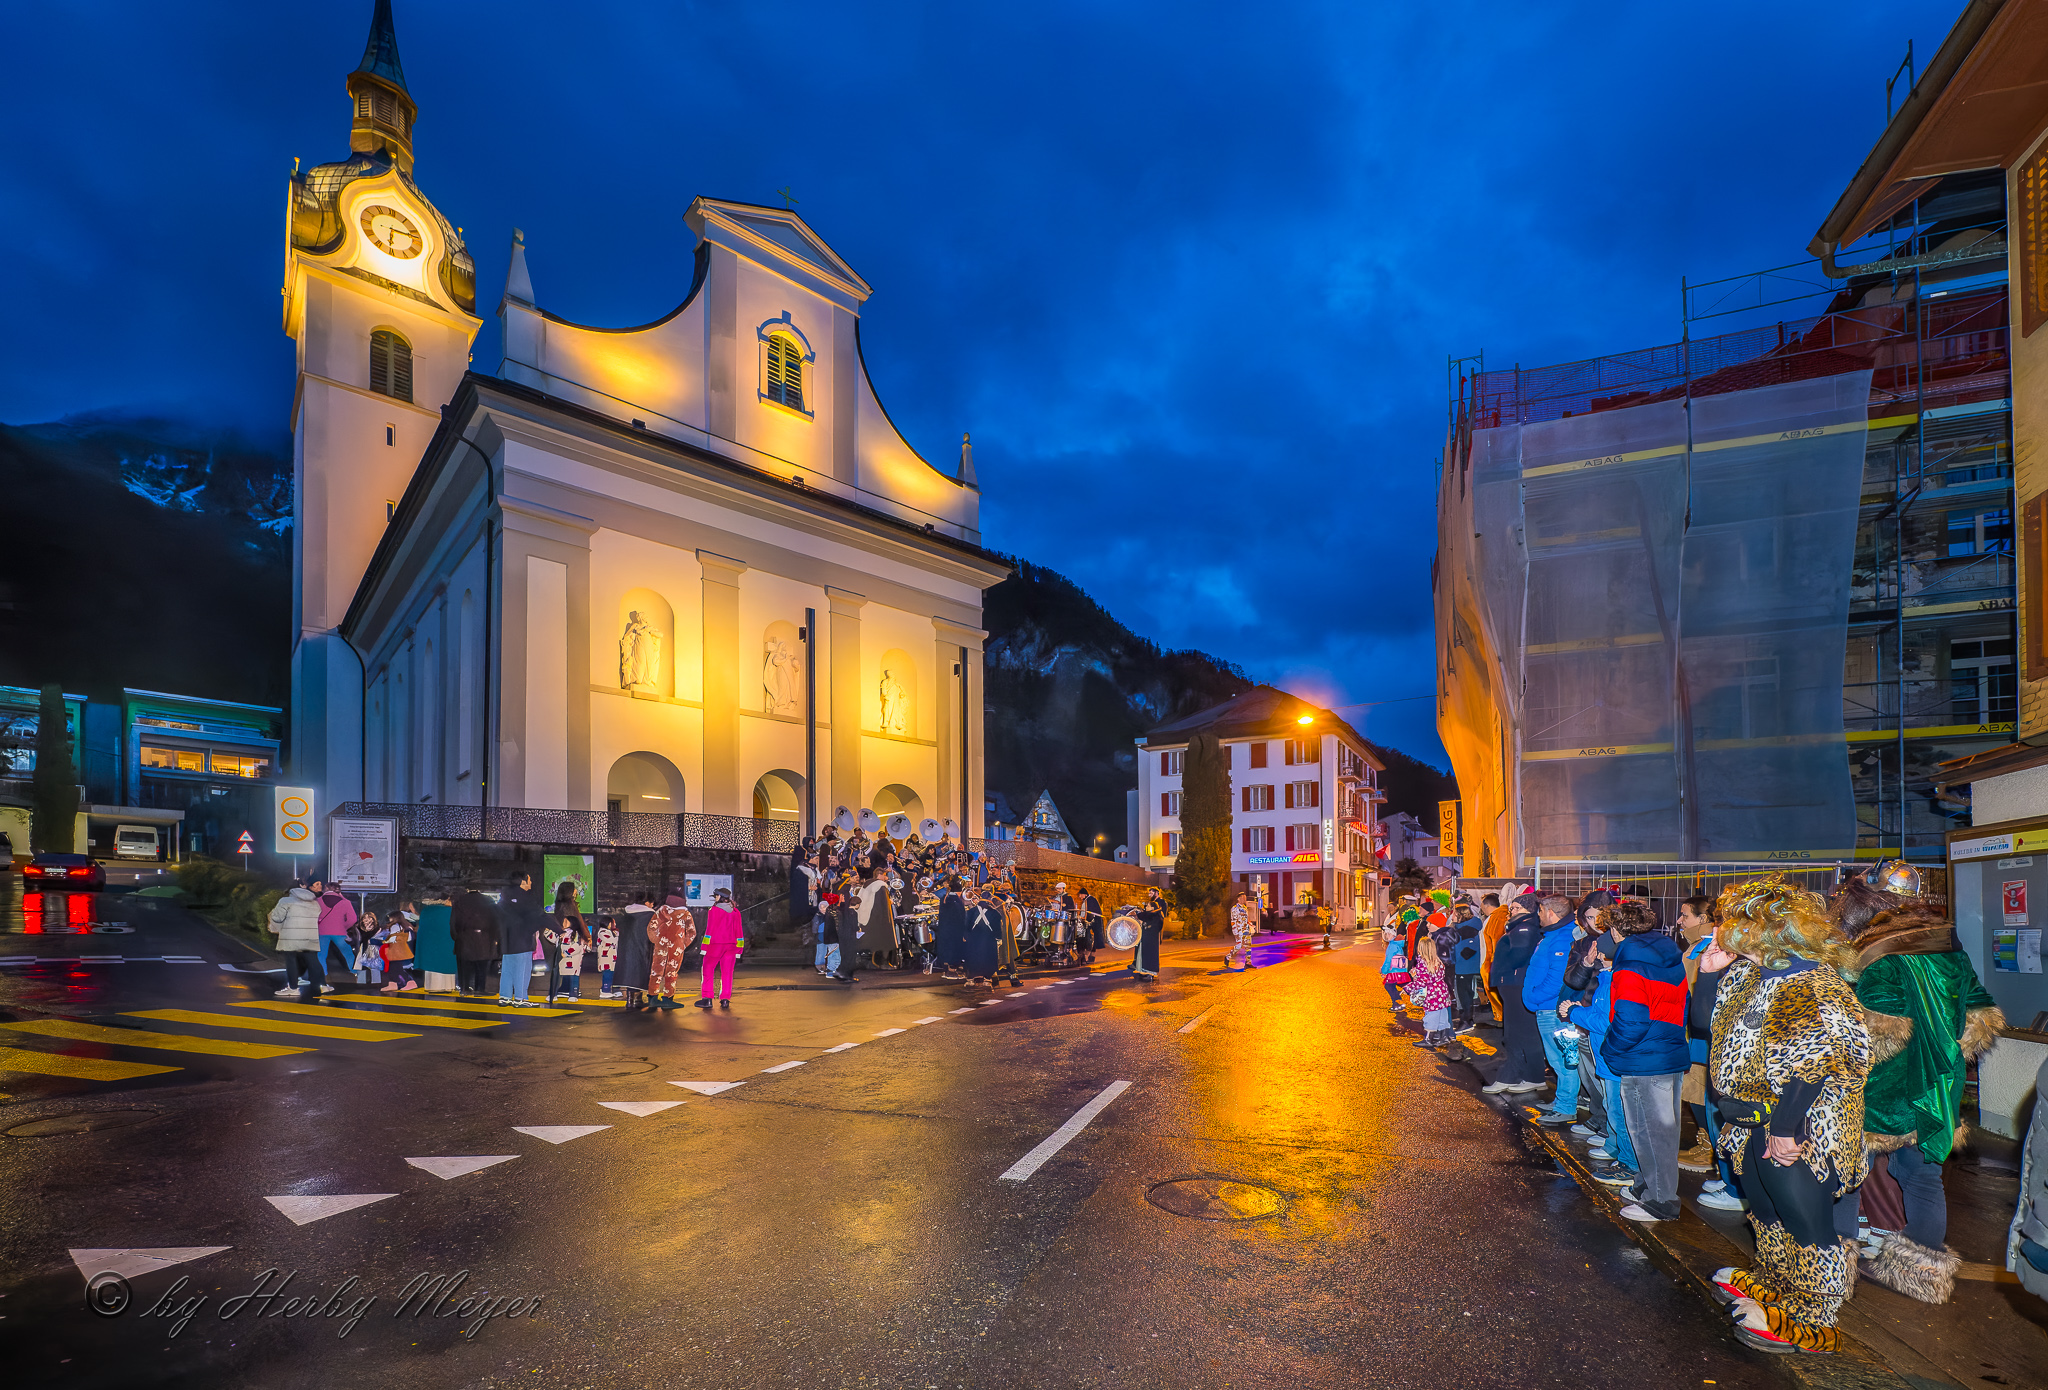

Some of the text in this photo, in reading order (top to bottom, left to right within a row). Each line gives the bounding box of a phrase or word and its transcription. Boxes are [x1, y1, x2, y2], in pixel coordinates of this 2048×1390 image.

[1779, 427, 1824, 440] ABAG
[1583, 454, 1623, 468] ABAG
[1578, 747, 1617, 757] ABAG
[1443, 810, 1453, 853] ABAG
[1324, 819, 1333, 861] HOTEL
[1249, 856, 1292, 864] RESTAURANT
[1767, 851, 1811, 860] ABAG
